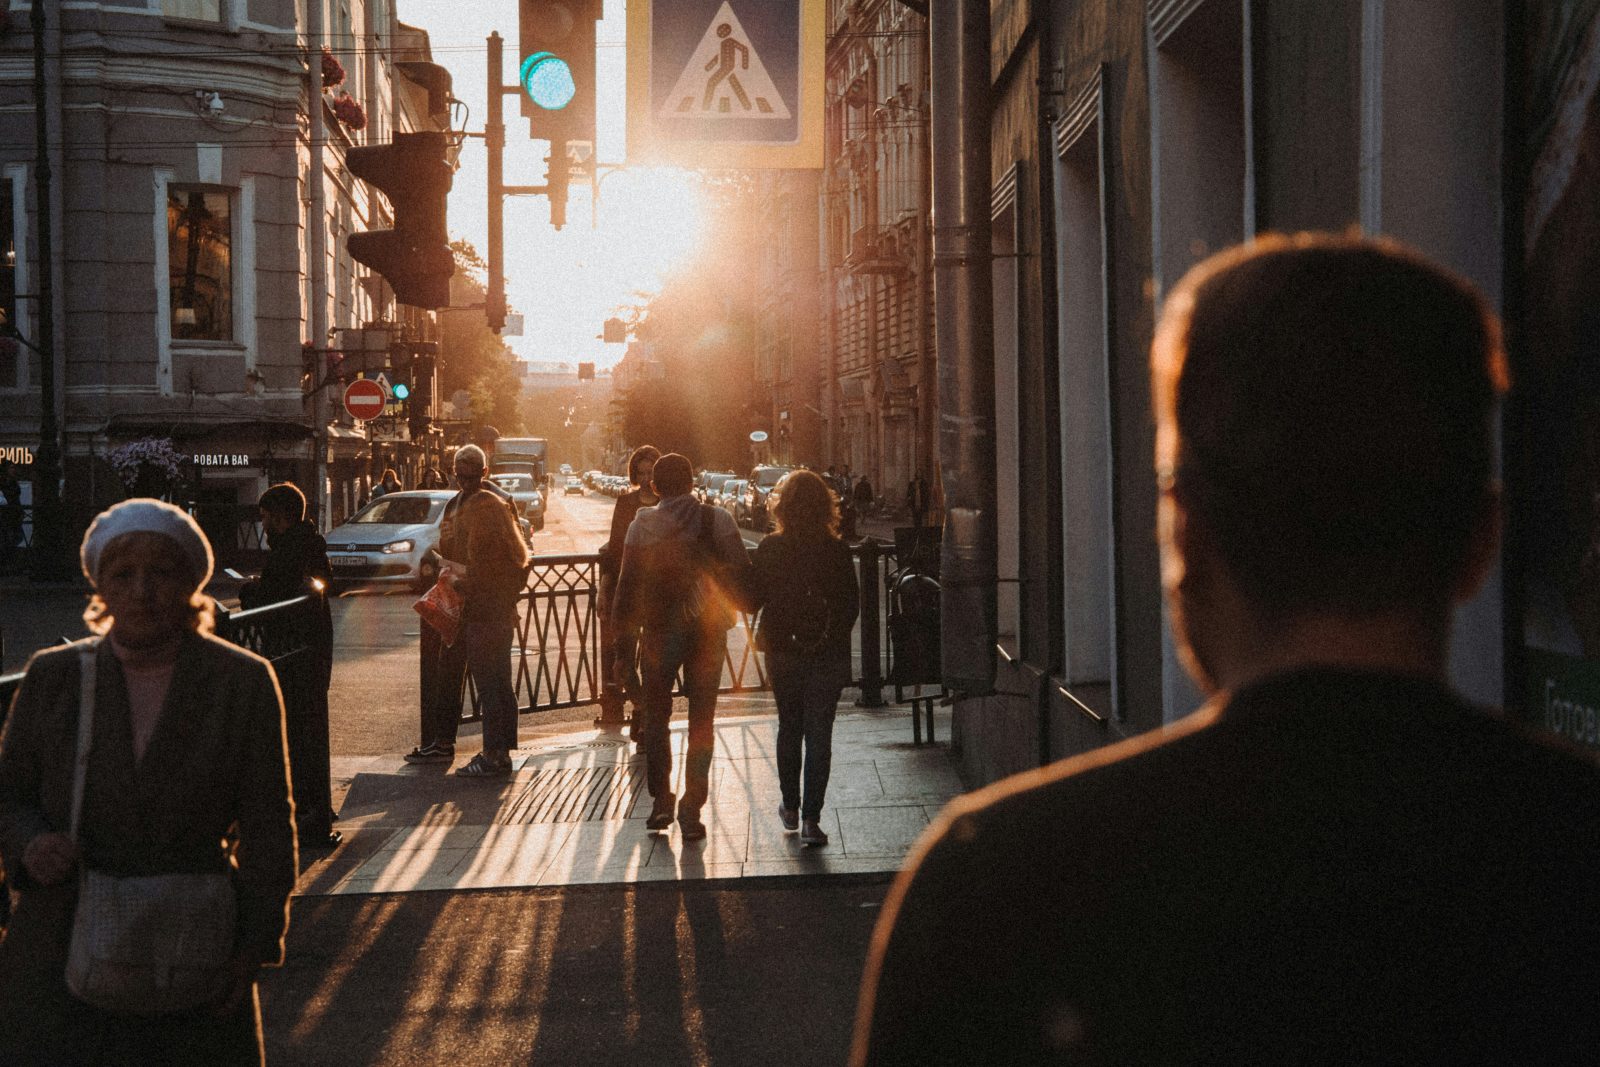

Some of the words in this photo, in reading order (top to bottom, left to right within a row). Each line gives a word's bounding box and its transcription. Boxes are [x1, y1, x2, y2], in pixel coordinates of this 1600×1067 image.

[0, 447, 33, 464] РИЛЬ
[194, 454, 229, 466] ROBATA
[232, 454, 249, 466] BAR
